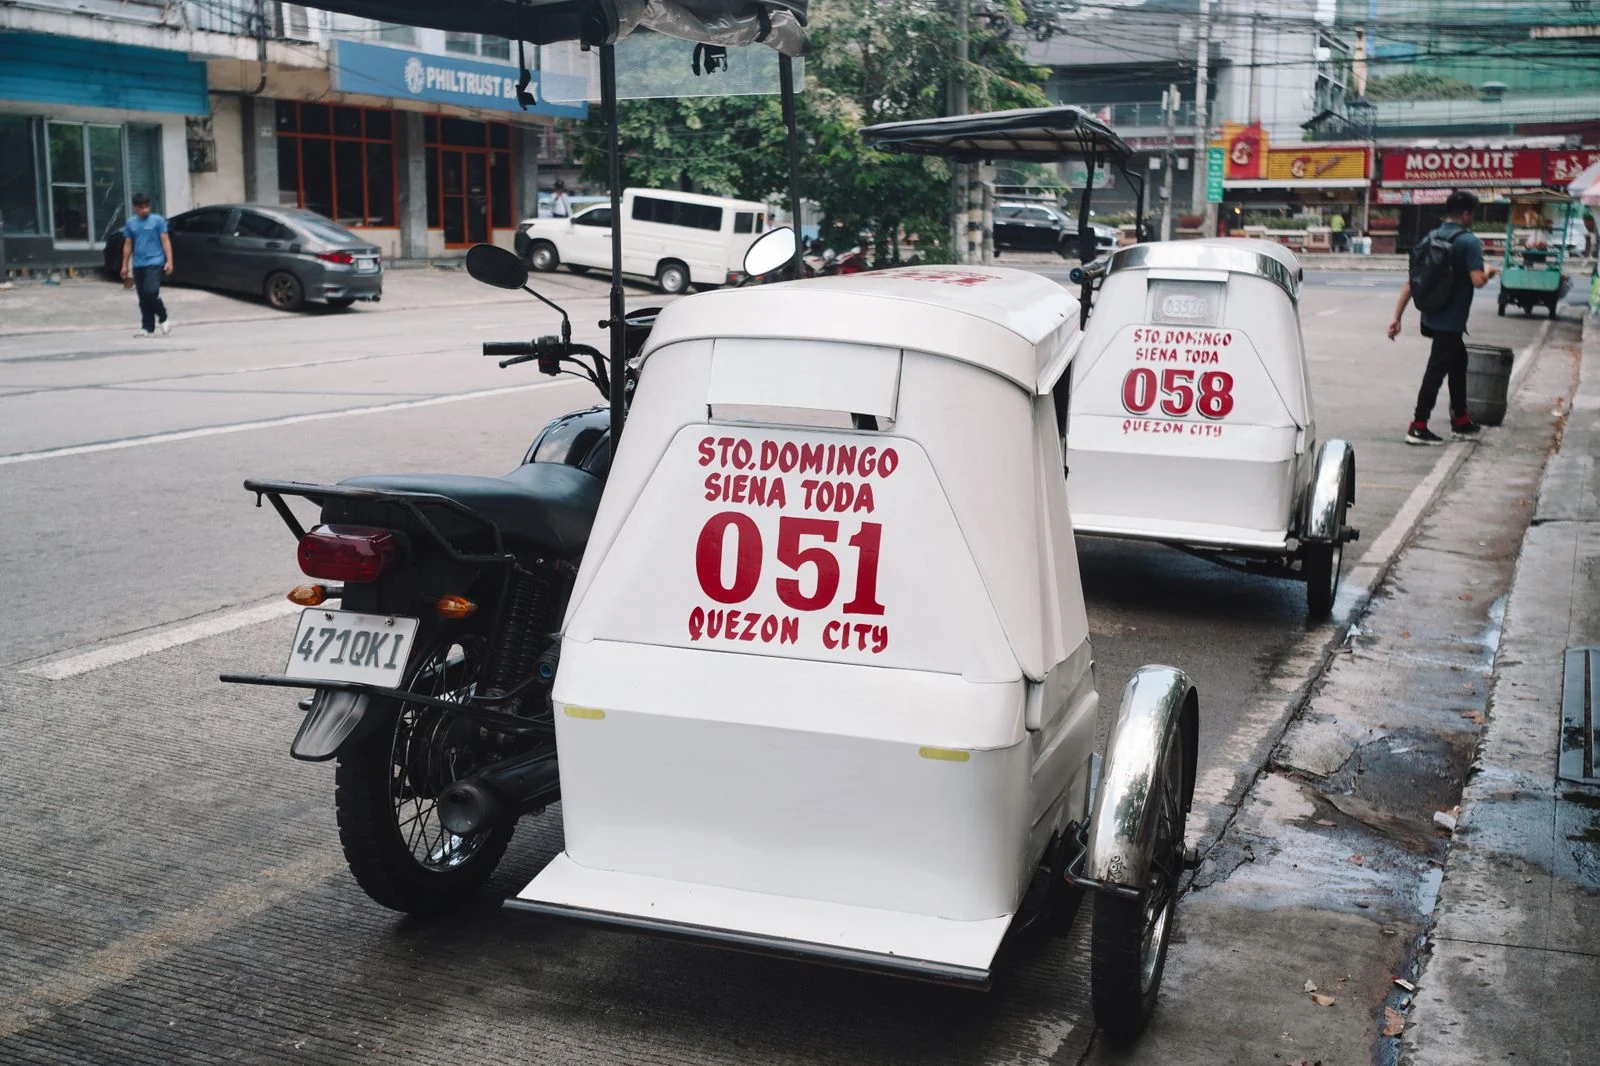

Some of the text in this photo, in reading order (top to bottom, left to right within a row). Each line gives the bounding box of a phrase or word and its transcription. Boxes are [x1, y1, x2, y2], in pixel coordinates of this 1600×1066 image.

[426, 66, 501, 97] PHILTRUST
[1406, 152, 1514, 170] MOTOLITE
[1136, 347, 1219, 364] SIENA TODA
[1121, 367, 1234, 421] 058
[1122, 419, 1222, 437] QUEZON CITY
[704, 472, 875, 513] SIENA TODA
[695, 511, 885, 614] 051
[297, 626, 404, 670] 471QKI
[687, 606, 889, 655] QUEZON CITY
